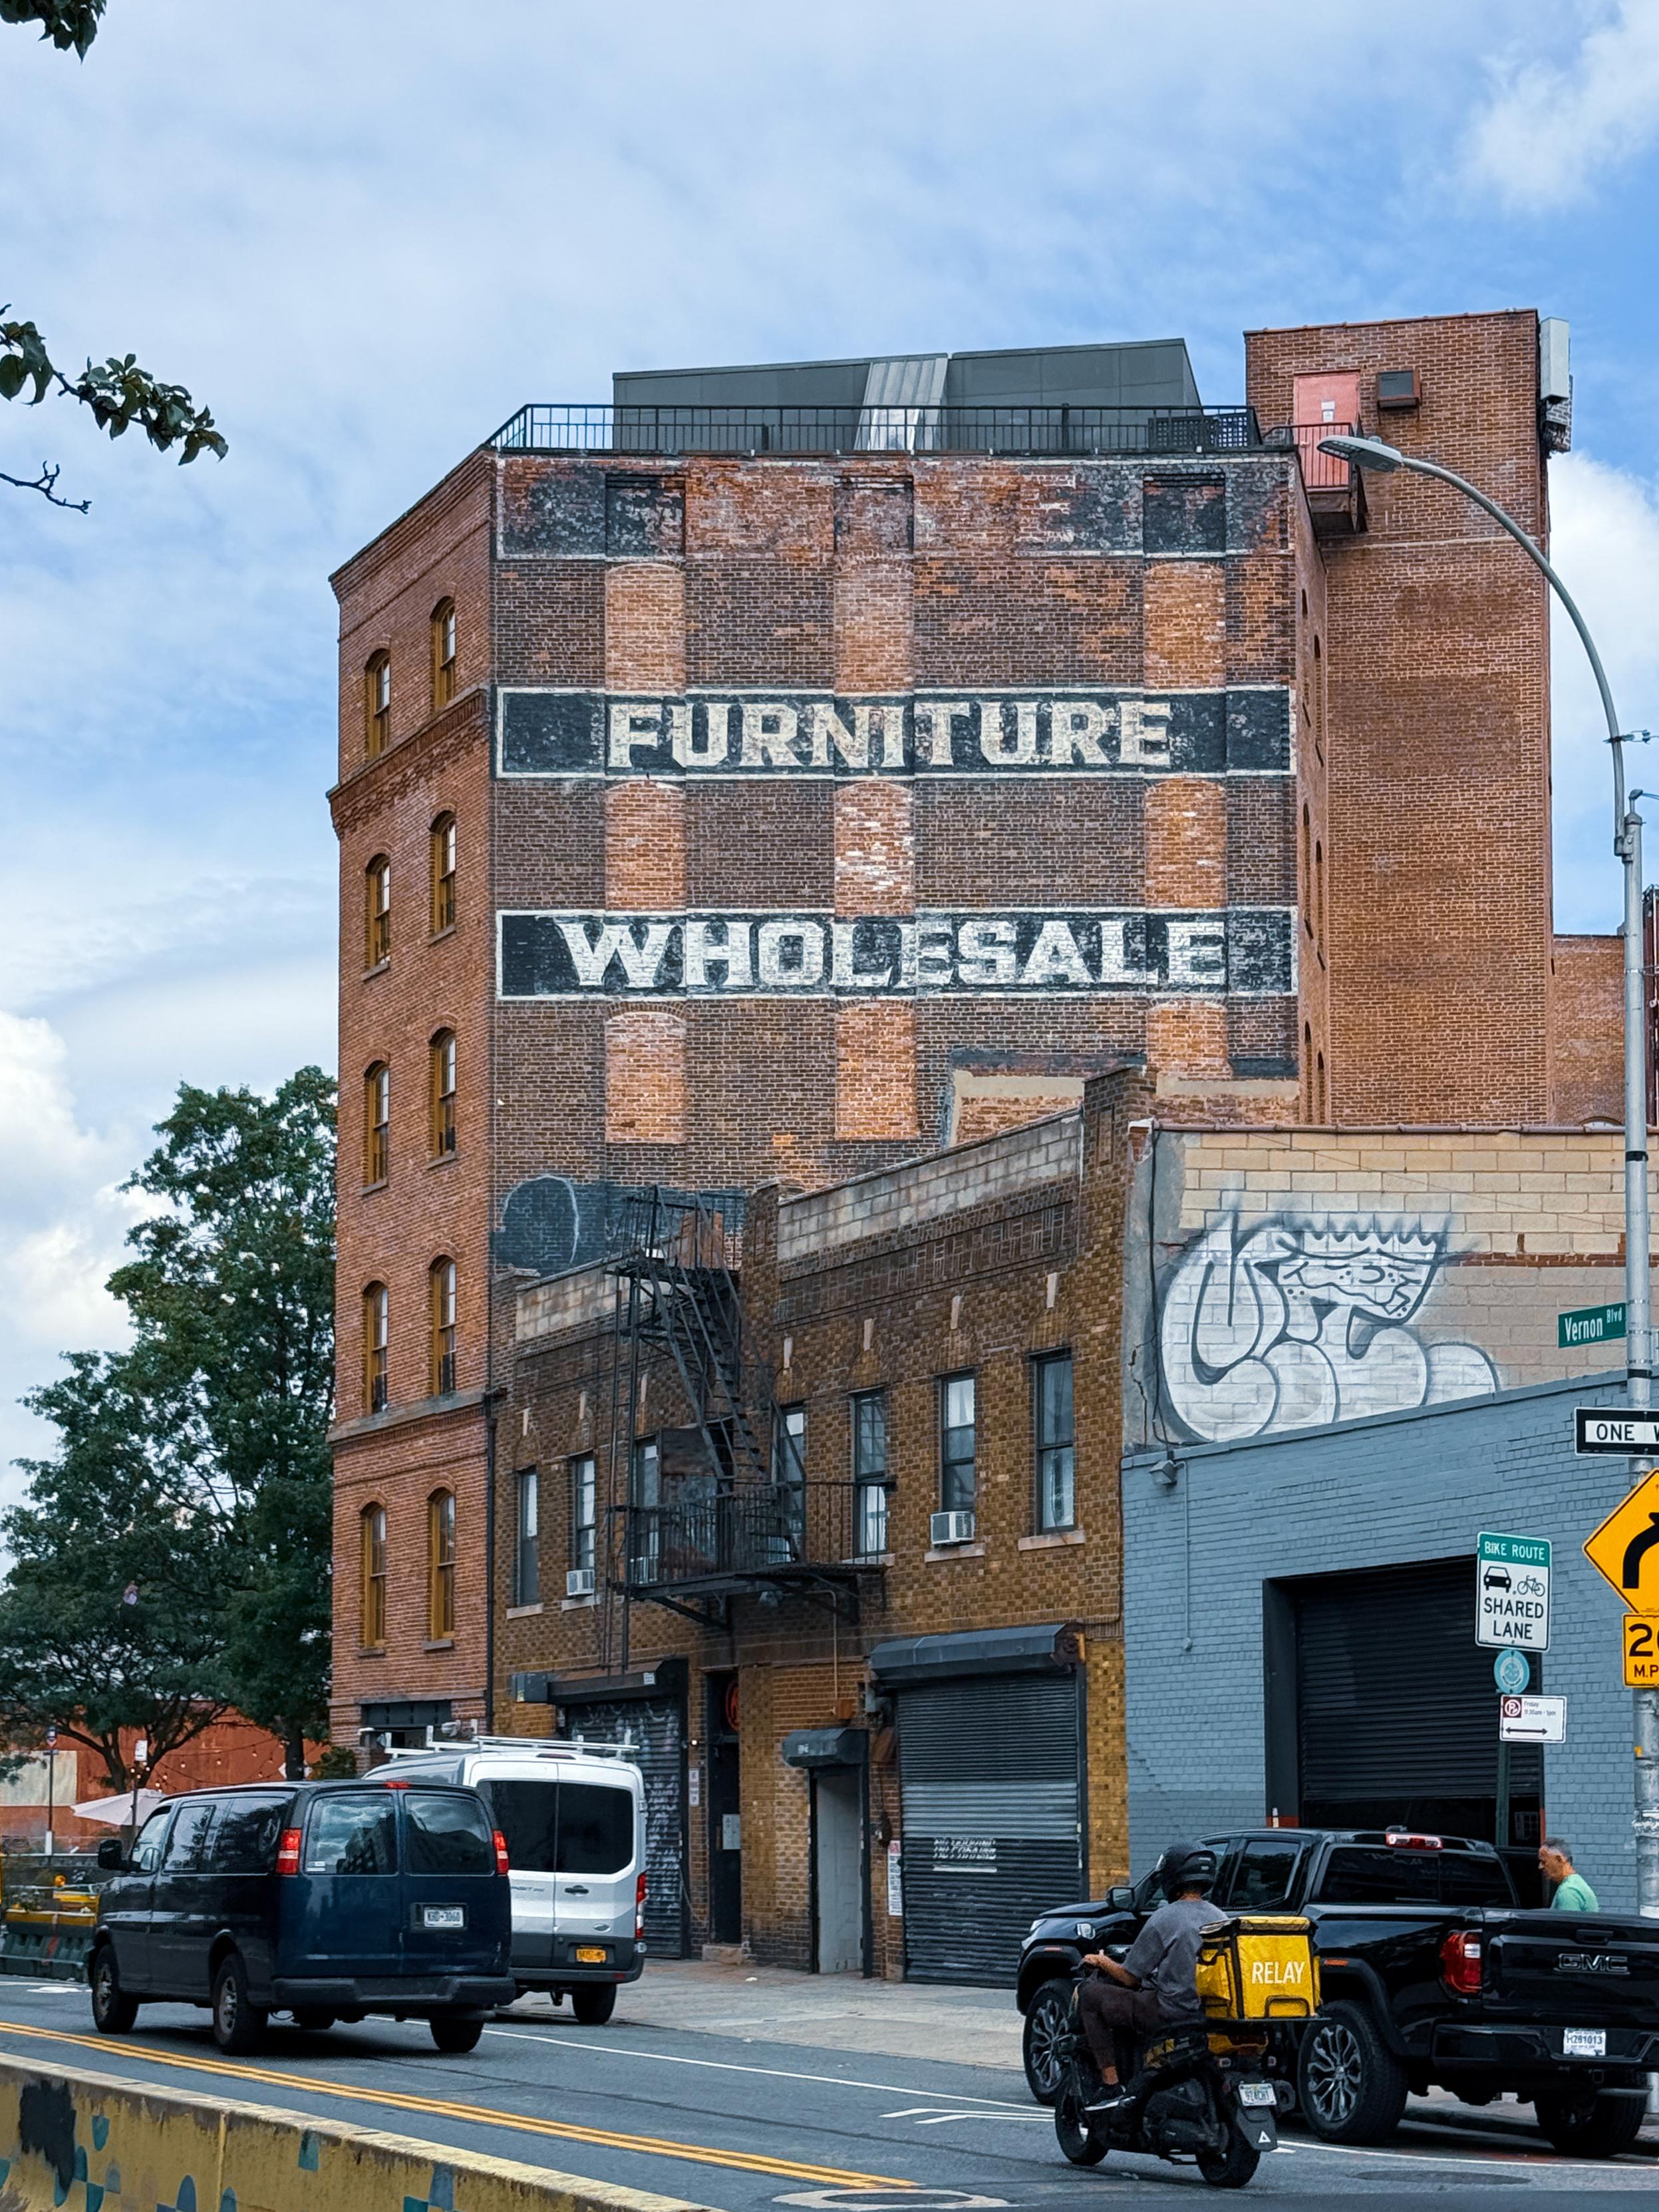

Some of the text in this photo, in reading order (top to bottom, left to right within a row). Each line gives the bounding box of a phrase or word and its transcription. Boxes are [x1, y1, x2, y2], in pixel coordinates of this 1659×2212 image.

[608, 701, 1171, 769] FURNITURE
[553, 919, 1228, 987] WHOLESALE
[1564, 1306, 1622, 1342] Vernon Blvd
[1596, 1423, 1634, 1441] ONE
[1484, 1541, 1545, 1561] BIKE ROUTE
[1483, 1597, 1544, 1619] SHARED
[1493, 1620, 1533, 1640] LANE
[1628, 1623, 1659, 1657] 2
[1251, 1961, 1305, 1984] RELAY
[1558, 1953, 1628, 1972] GMC
